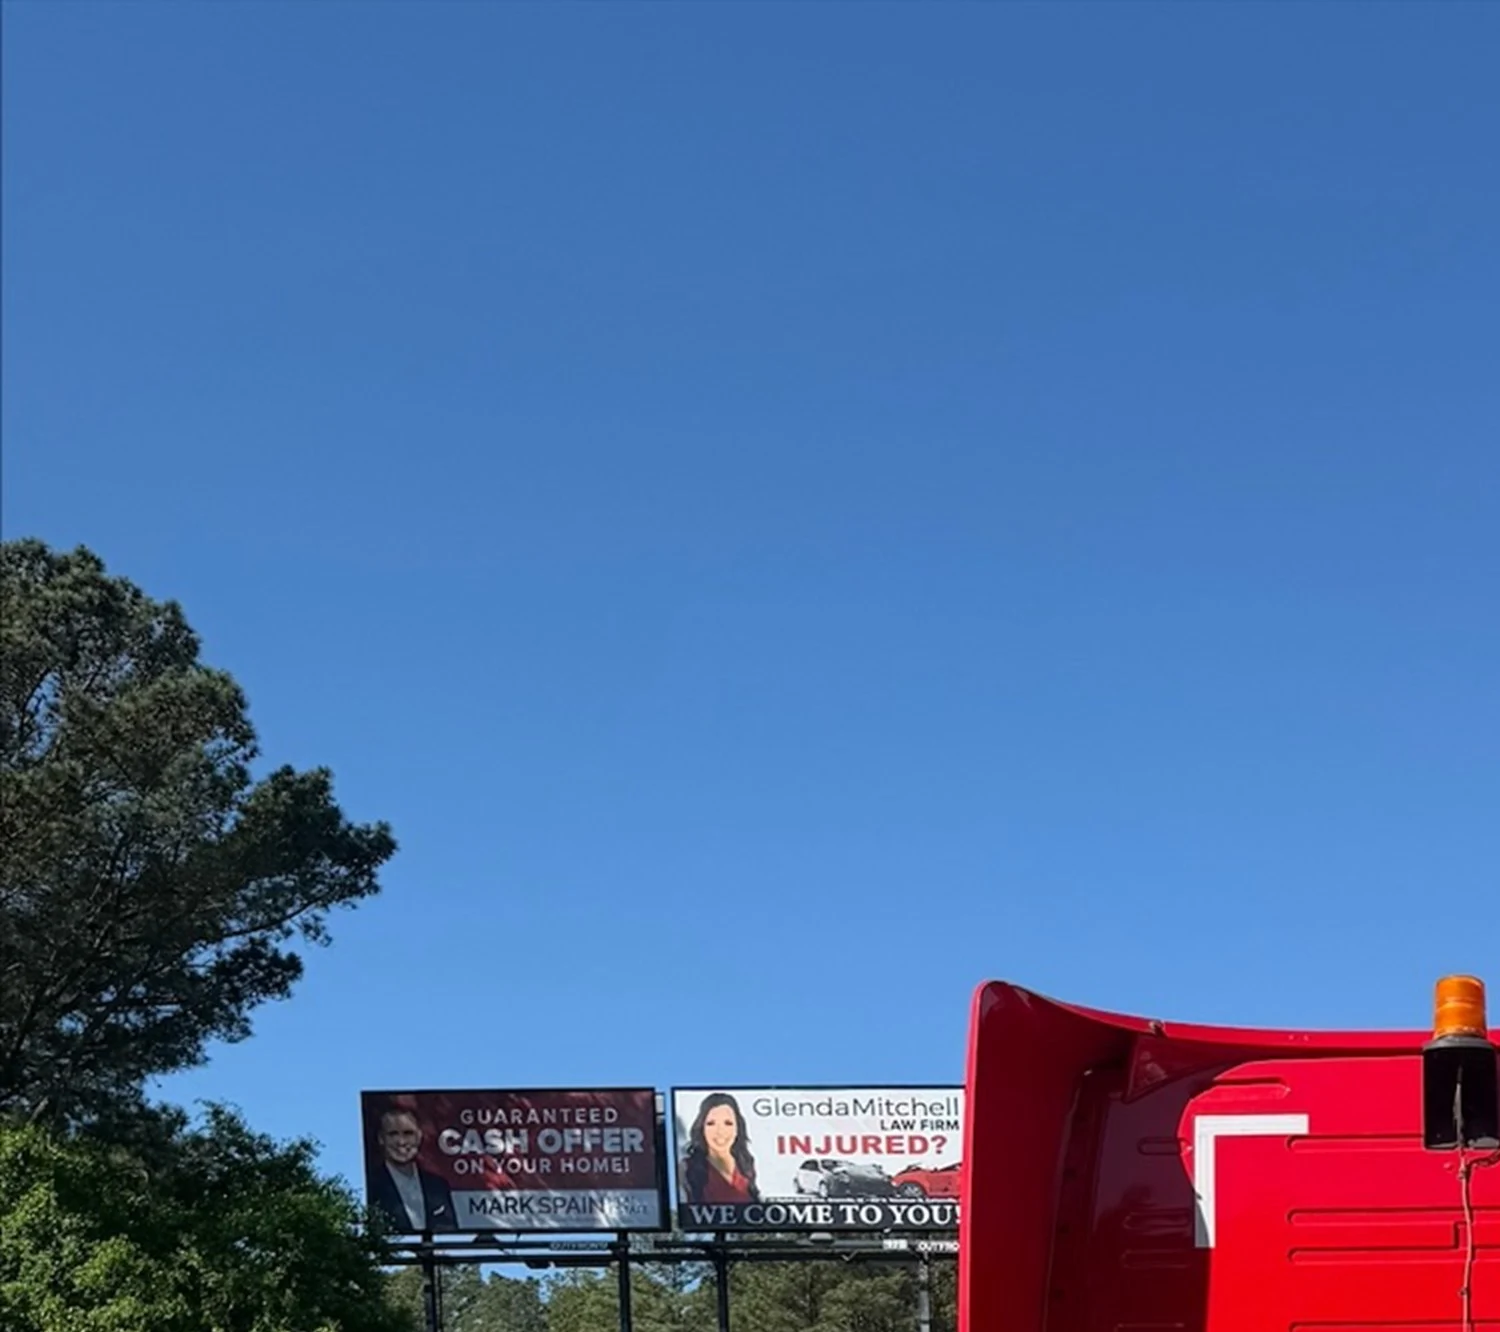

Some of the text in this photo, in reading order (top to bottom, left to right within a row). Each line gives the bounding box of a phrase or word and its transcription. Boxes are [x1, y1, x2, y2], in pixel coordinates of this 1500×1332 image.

[459, 1107, 618, 1124] GUARANTEED
[880, 1119, 960, 1131] LAW FIRM
[438, 1127, 645, 1155] CASH OFFER
[777, 1134, 948, 1155] INJURED?
[454, 1157, 630, 1174] ON YOUR HOME!
[690, 1203, 961, 1224] WE COME TO YOU!
